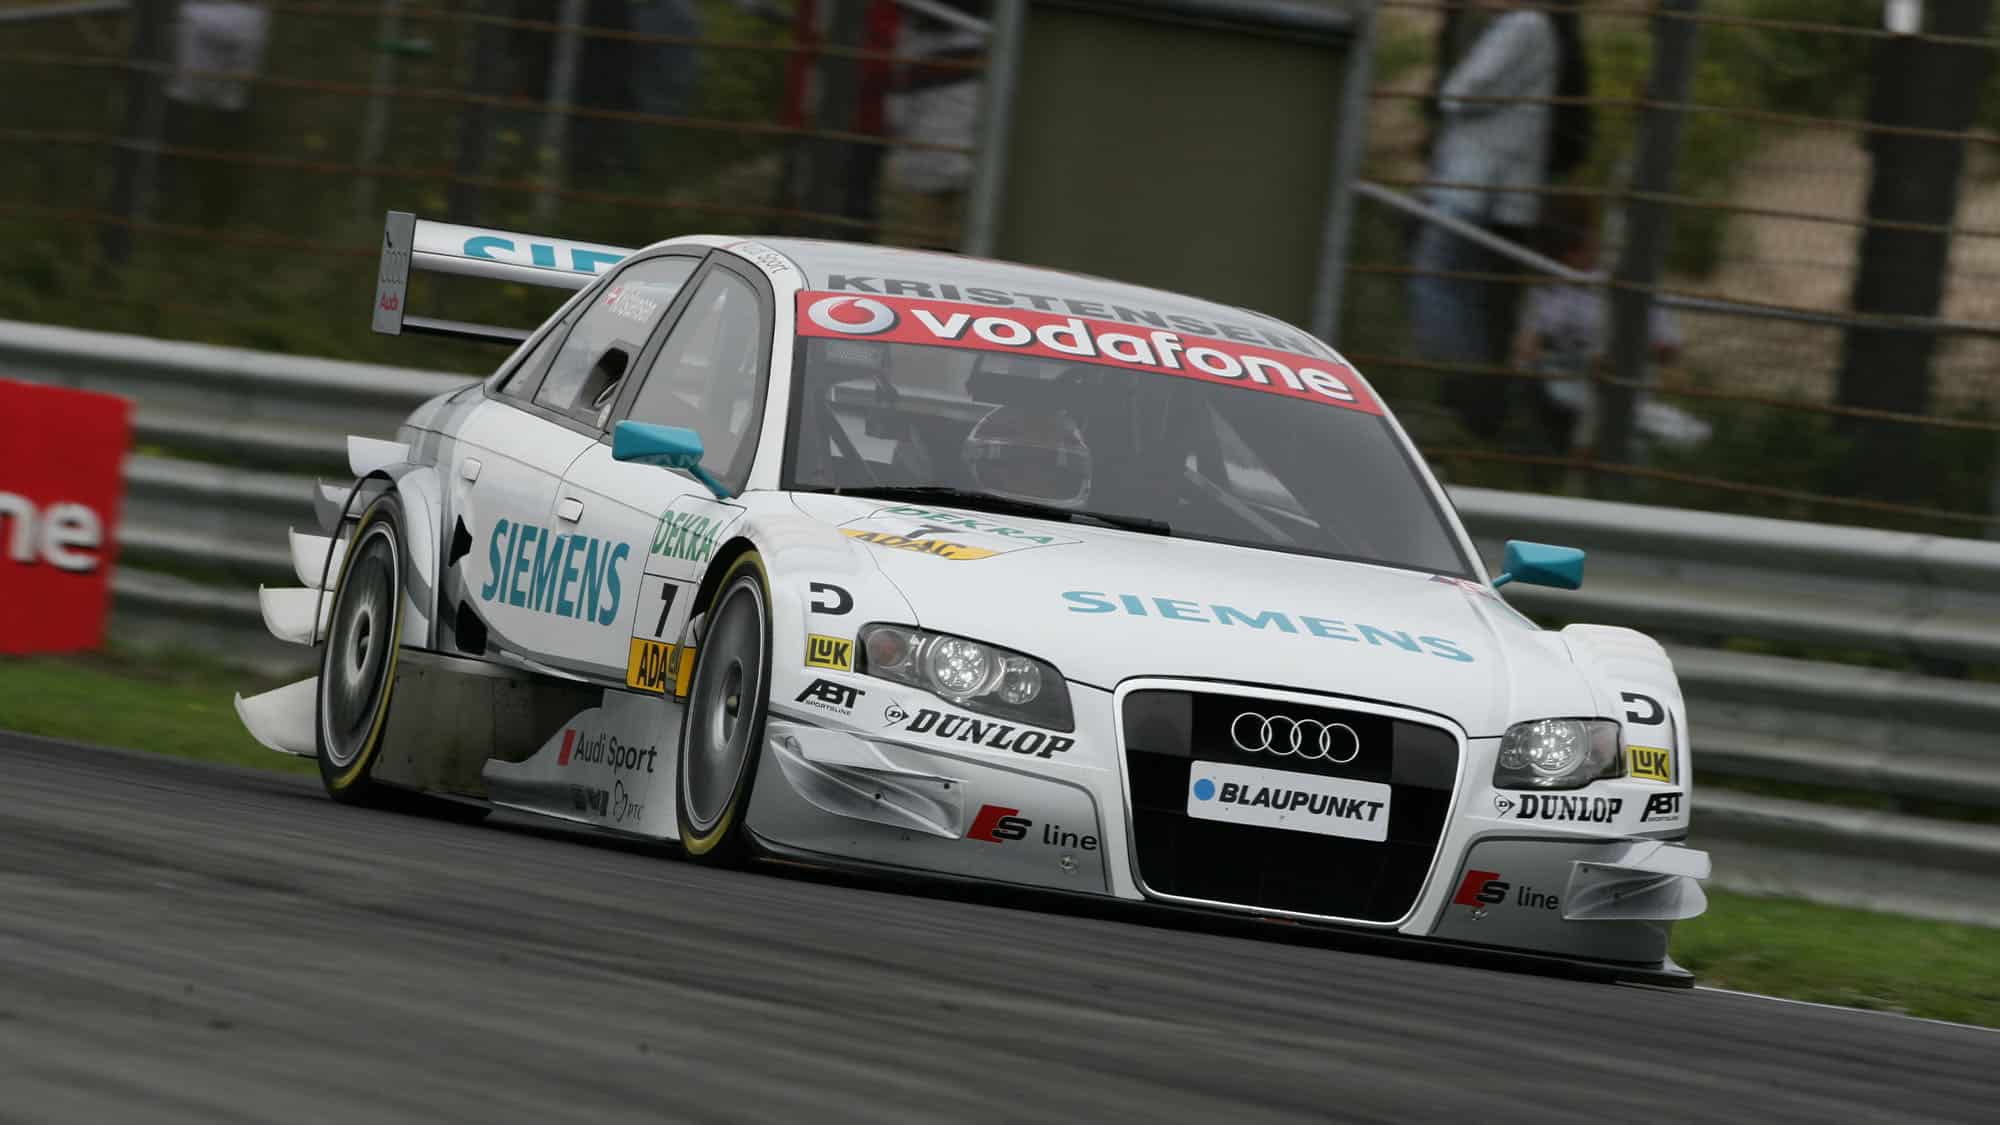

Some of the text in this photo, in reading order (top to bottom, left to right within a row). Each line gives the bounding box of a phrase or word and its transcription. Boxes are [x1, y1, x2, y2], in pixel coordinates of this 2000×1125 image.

[827, 274, 1323, 355] KRISTENSEN
[912, 306, 1358, 402] vodafone
[651, 510, 724, 562] DEKRA
[887, 506, 1055, 545] DEKRA
[481, 518, 631, 626] SIEMENS
[1062, 590, 1476, 663] SIEMENS
[795, 678, 866, 708] ABT
[575, 730, 657, 776] Audi Sport
[906, 708, 1075, 760] DUNLOP
[1218, 782, 1384, 822] BLAUPUNKT
[1516, 793, 1622, 823] DUNLOP
[1640, 792, 1684, 822] ABT
[991, 813, 1098, 851] S line
[1476, 880, 1559, 910] S line
